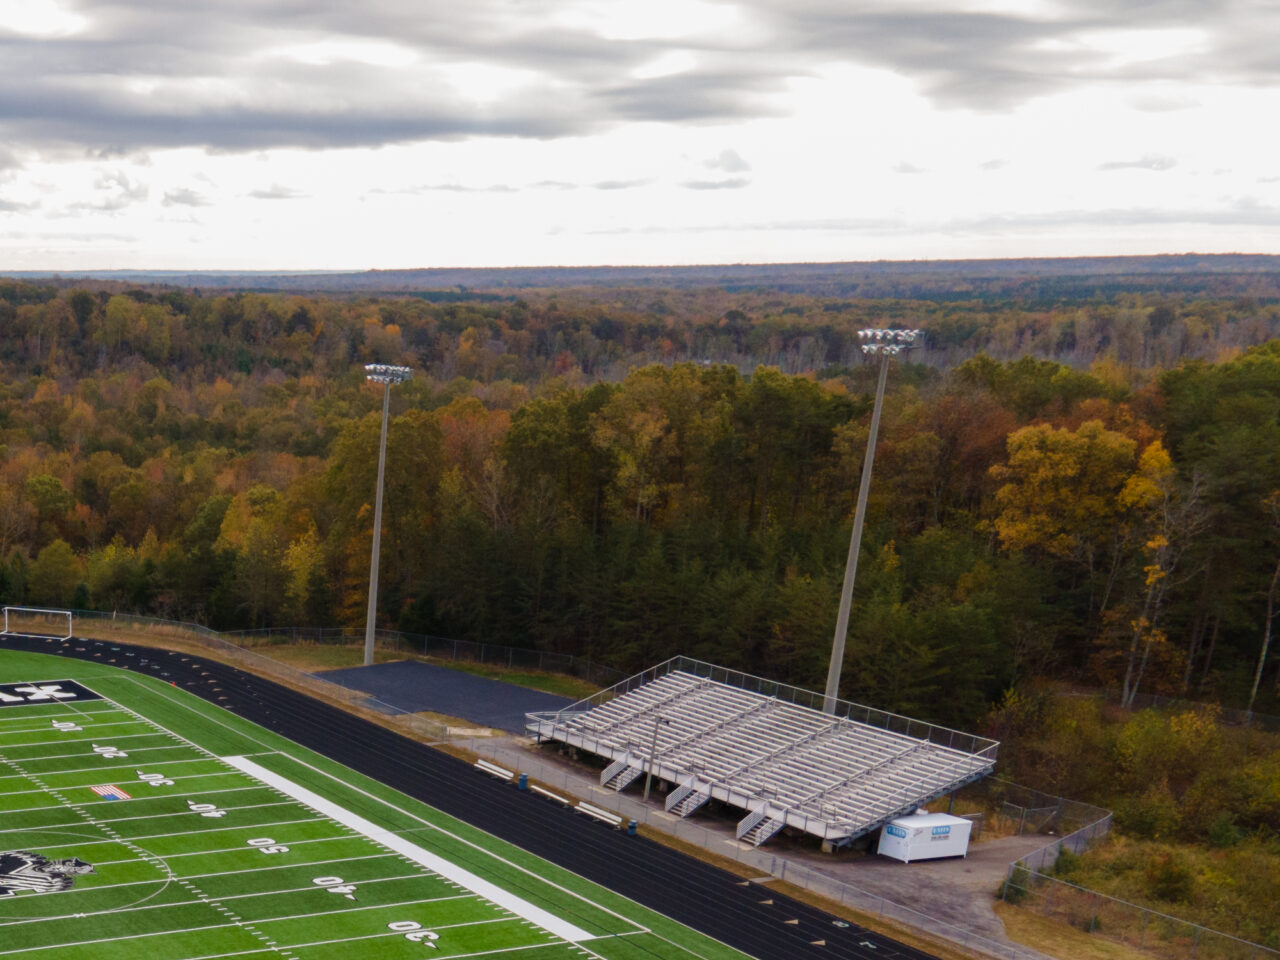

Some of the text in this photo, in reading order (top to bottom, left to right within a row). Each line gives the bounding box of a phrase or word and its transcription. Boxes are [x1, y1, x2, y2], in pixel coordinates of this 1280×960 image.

[139, 773, 175, 787] 30
[188, 803, 227, 818] 40
[247, 837, 290, 855] 50
[312, 876, 358, 894] 40
[387, 920, 440, 942] 30
